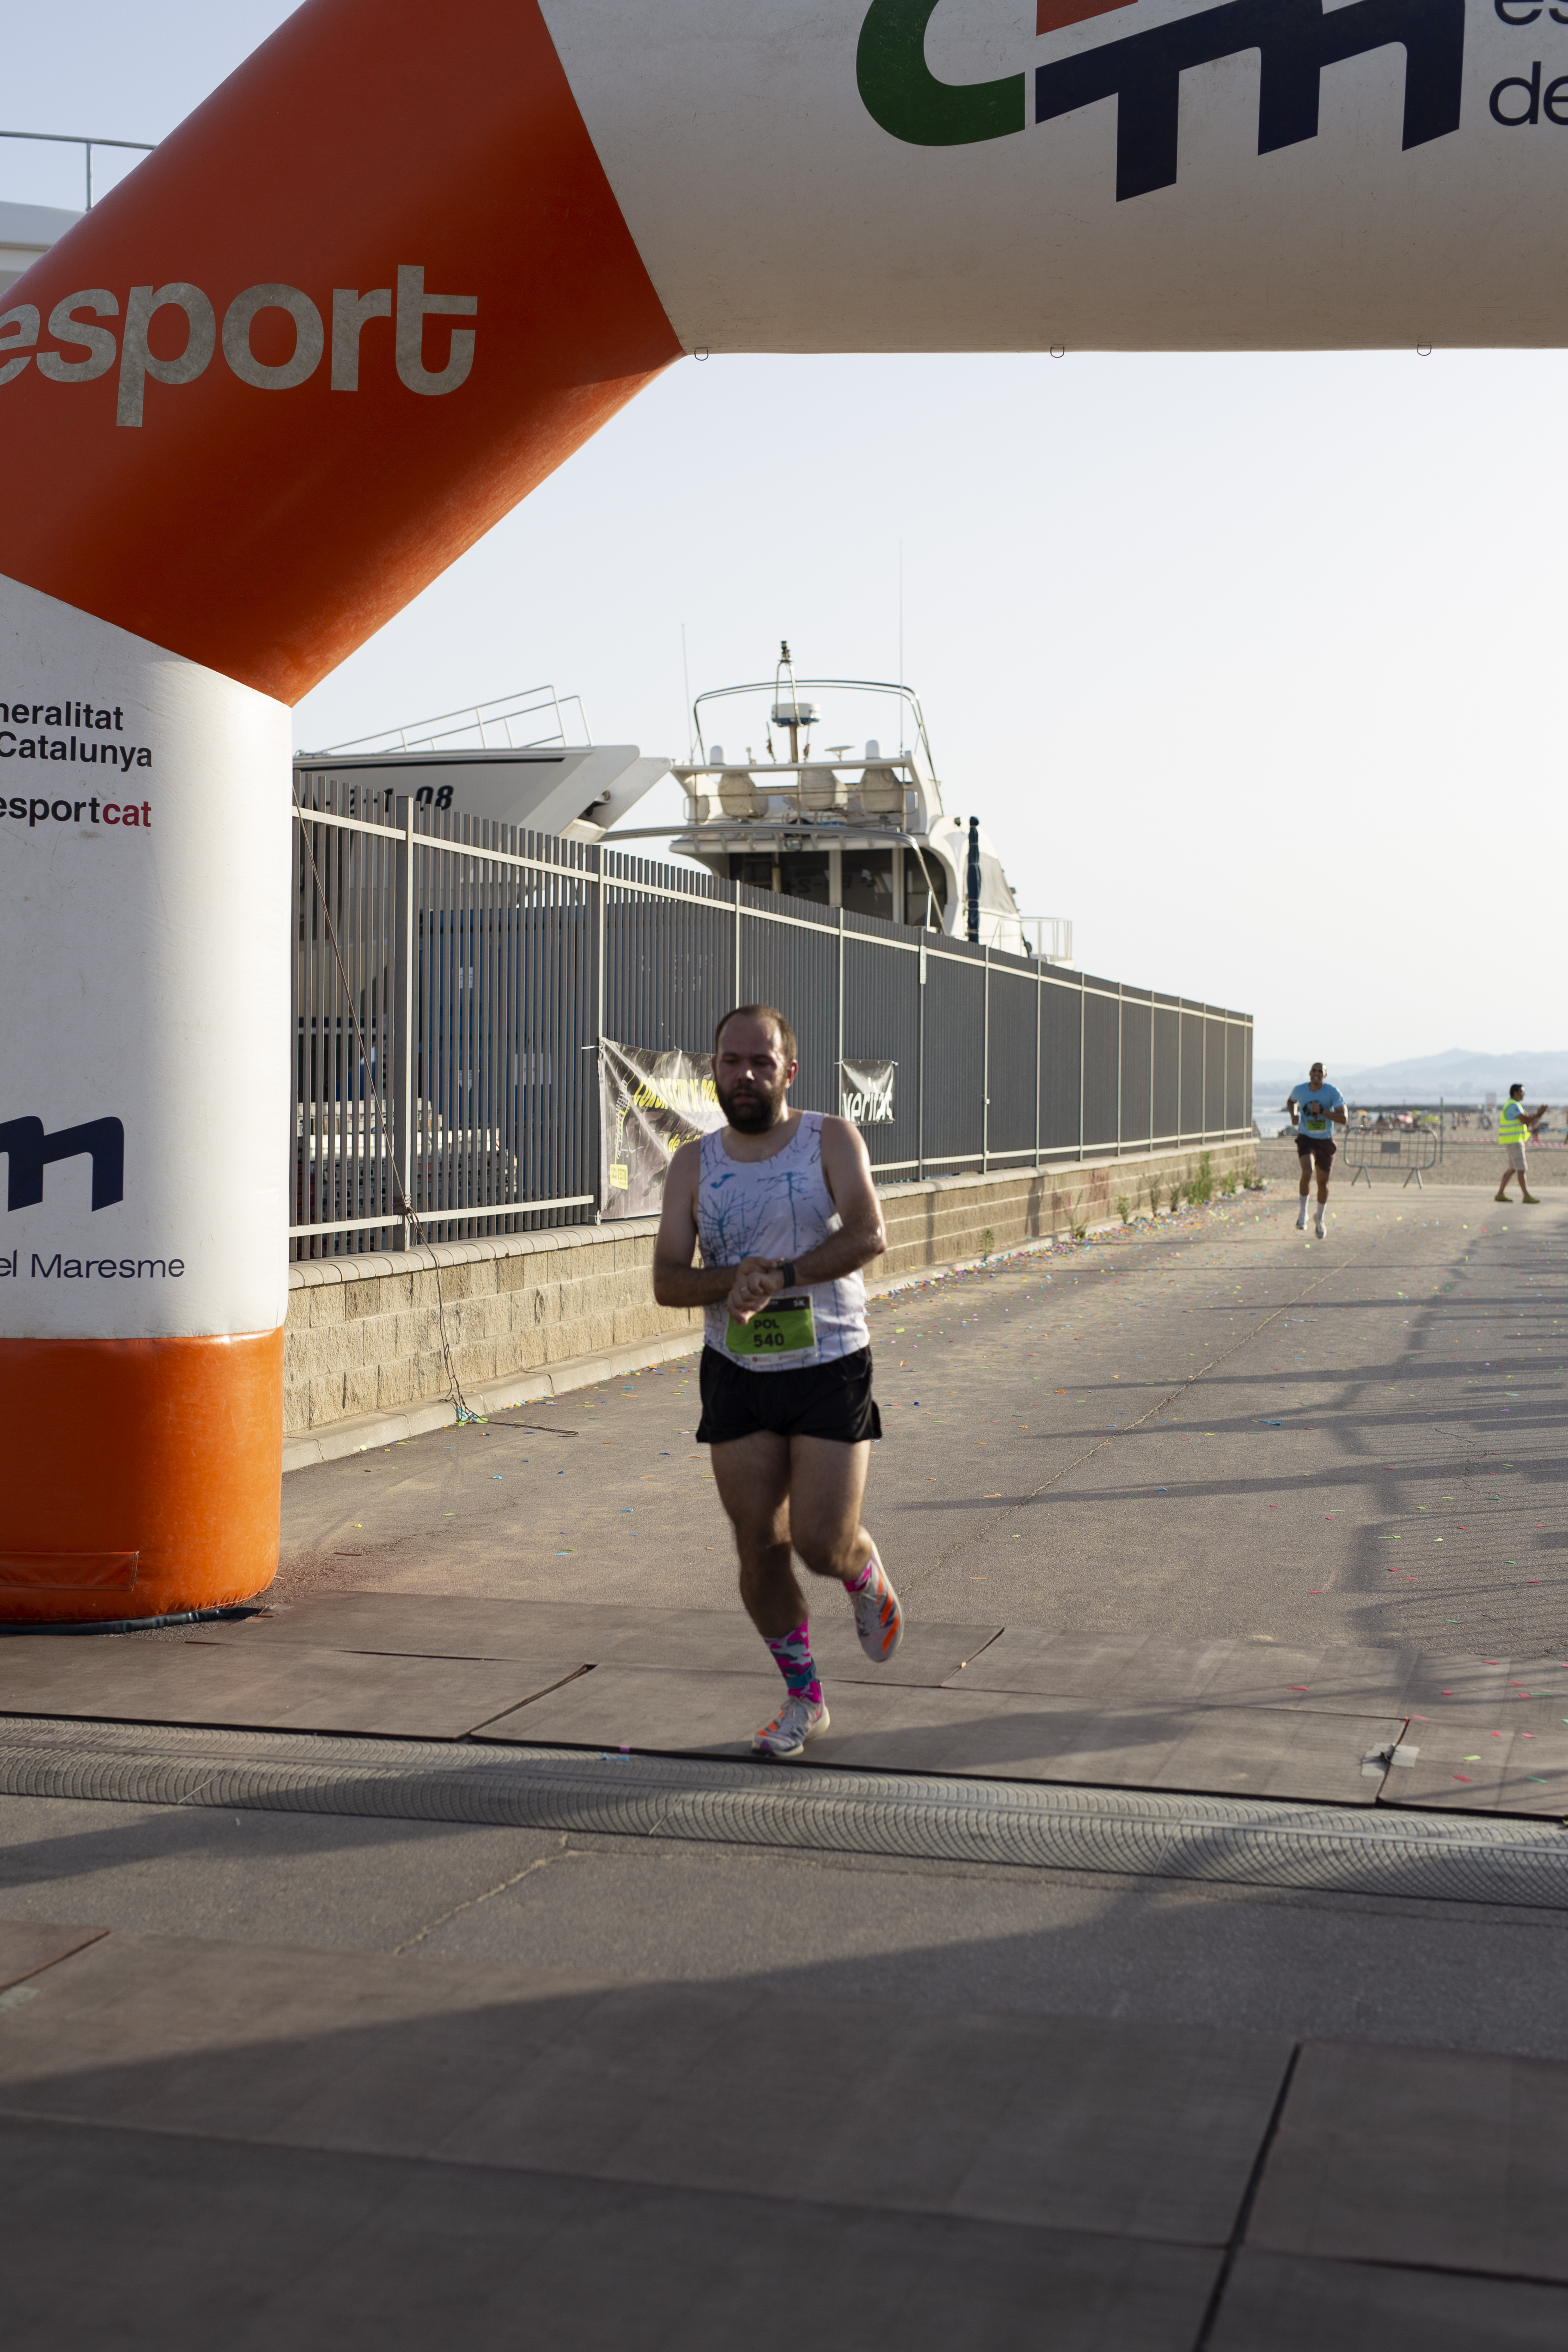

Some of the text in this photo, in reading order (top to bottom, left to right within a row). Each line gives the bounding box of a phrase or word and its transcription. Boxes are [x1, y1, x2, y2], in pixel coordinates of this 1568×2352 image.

[0, 731, 153, 772] Catalunya
[668, 1133, 680, 1152] de
[31, 1254, 185, 1278] Maresme
[754, 1319, 780, 1330] POL
[753, 1333, 784, 1348] 540
